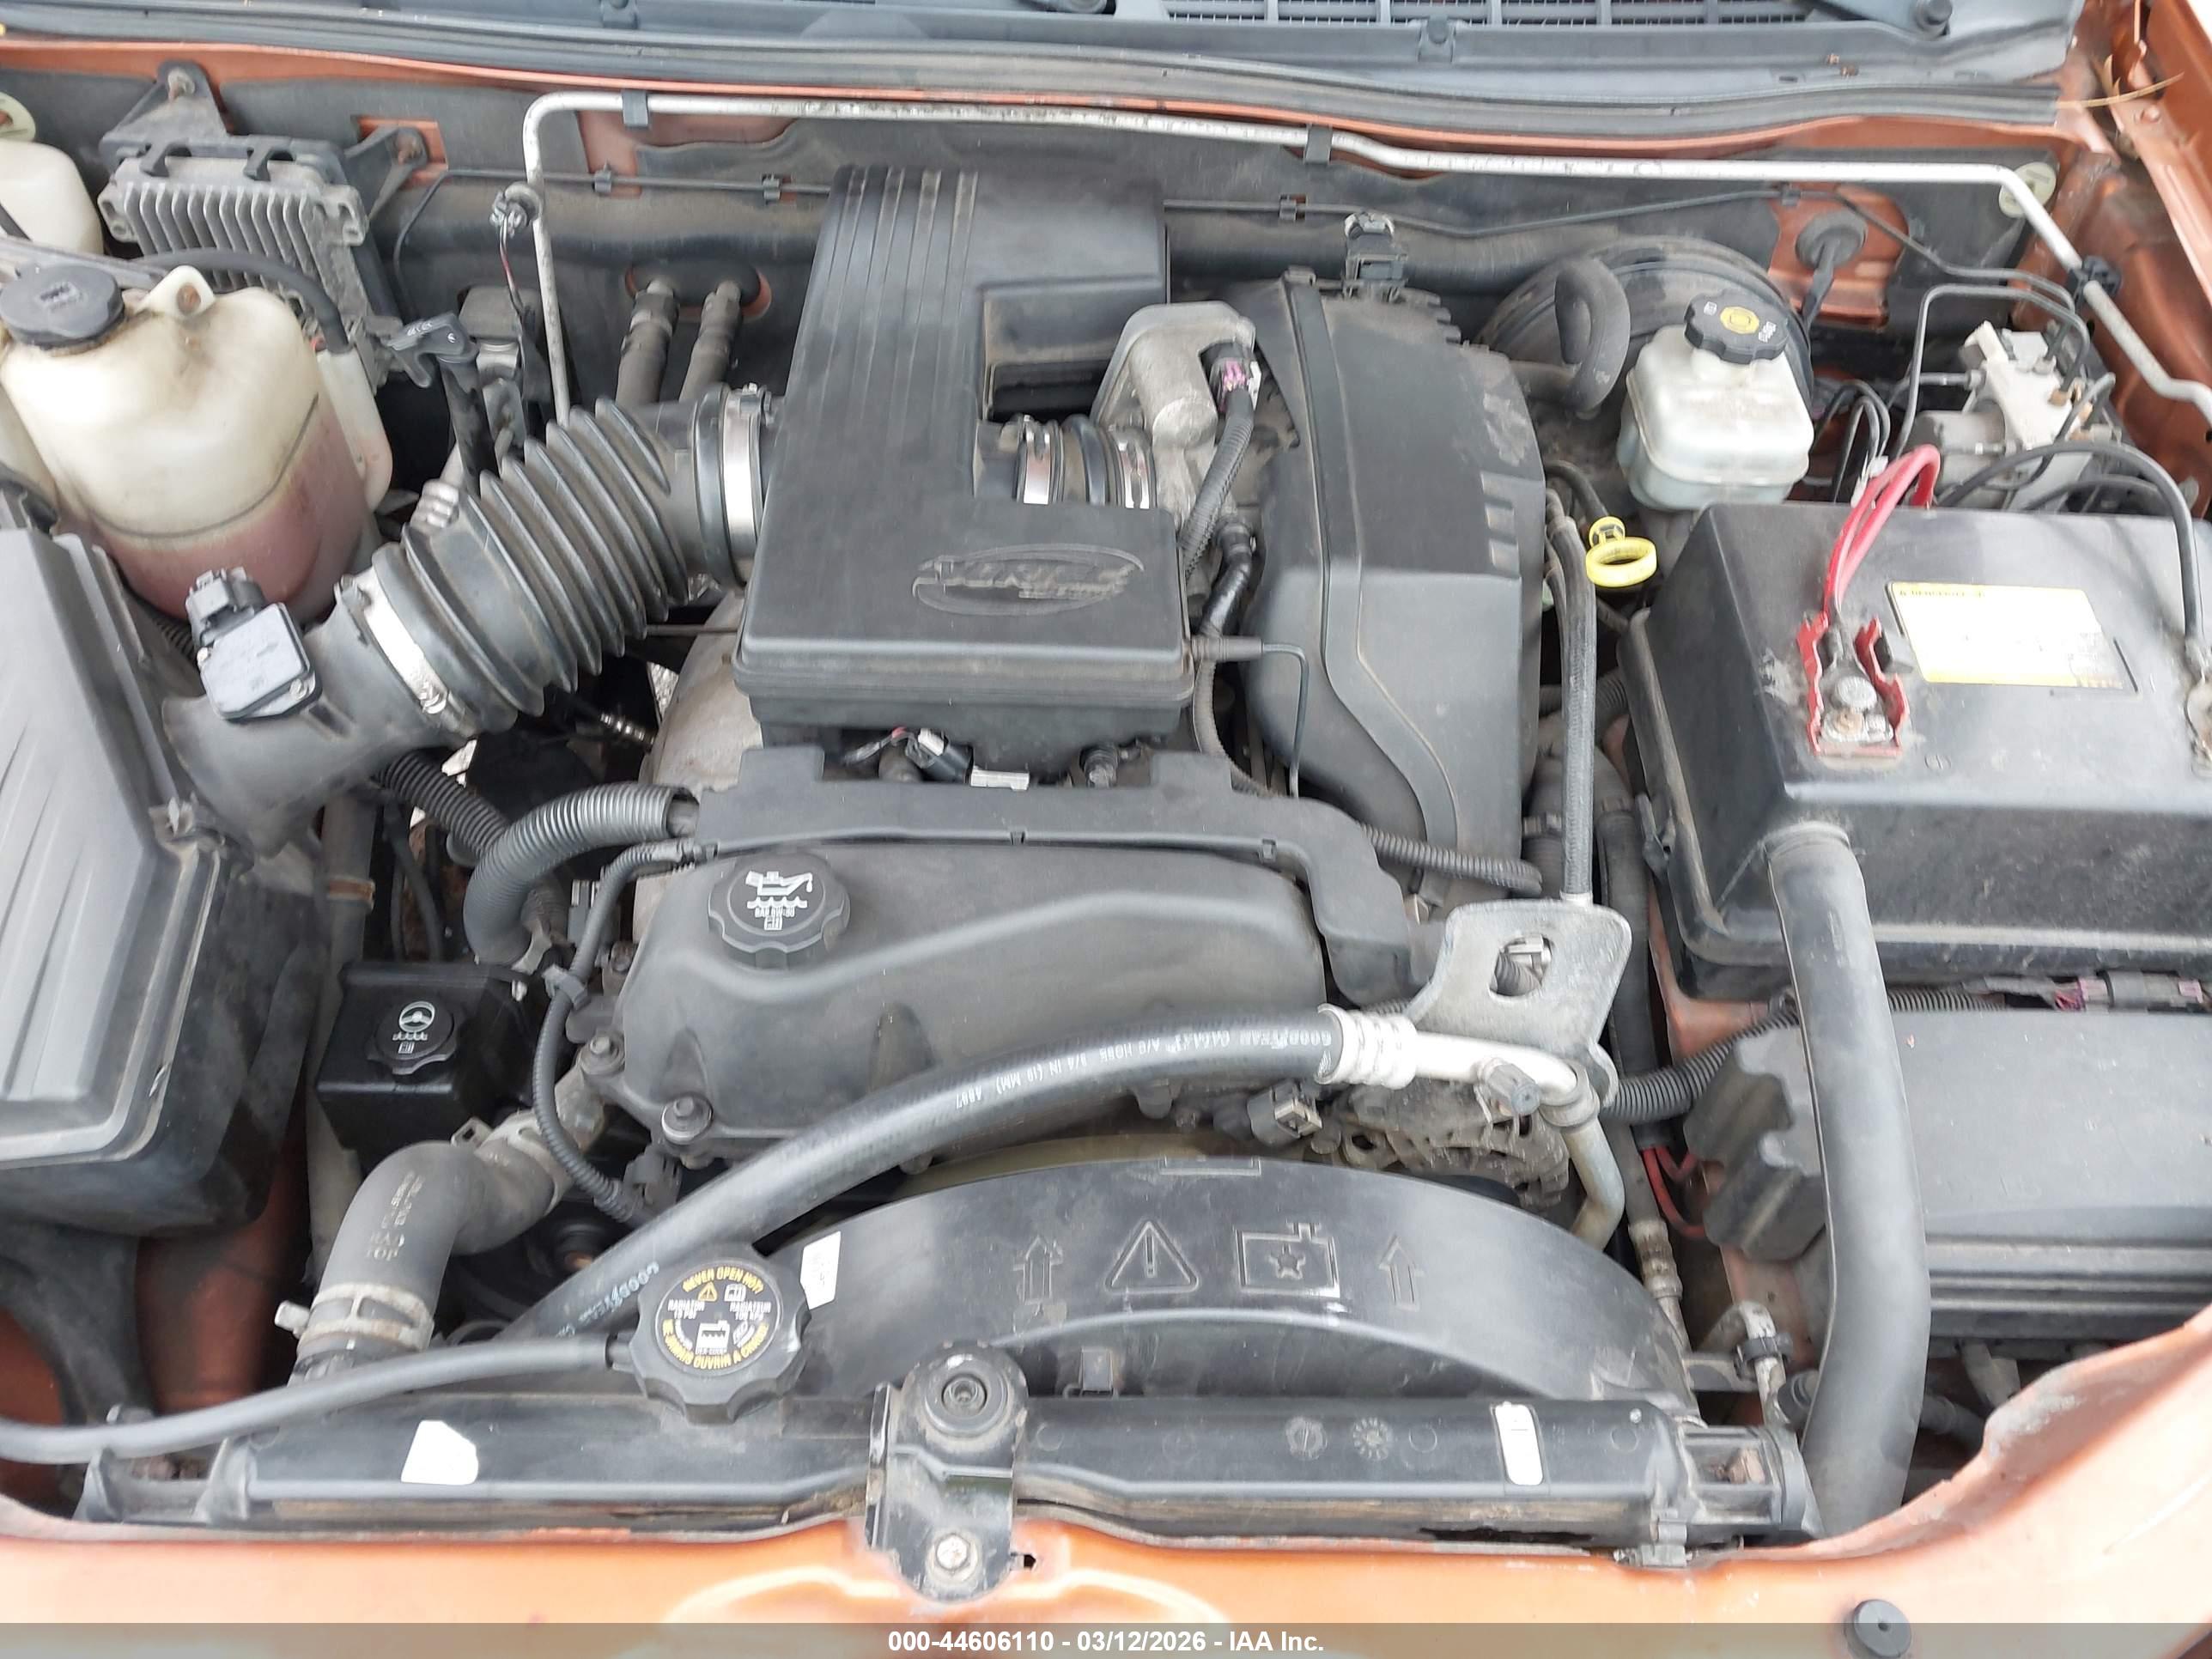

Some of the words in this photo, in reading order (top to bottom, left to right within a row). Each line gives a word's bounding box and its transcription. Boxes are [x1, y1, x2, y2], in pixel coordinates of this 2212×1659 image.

[1241, 1028, 1332, 1049] GOODYEAR
[1048, 1059, 1062, 1076] IN
[996, 1071, 1022, 1095] MM)
[683, 1268, 715, 1291] NEVER
[716, 1267, 744, 1282] OPEN
[578, 1261, 659, 1327] GOODYEAR
[694, 1354, 732, 1370] OUVRIR
